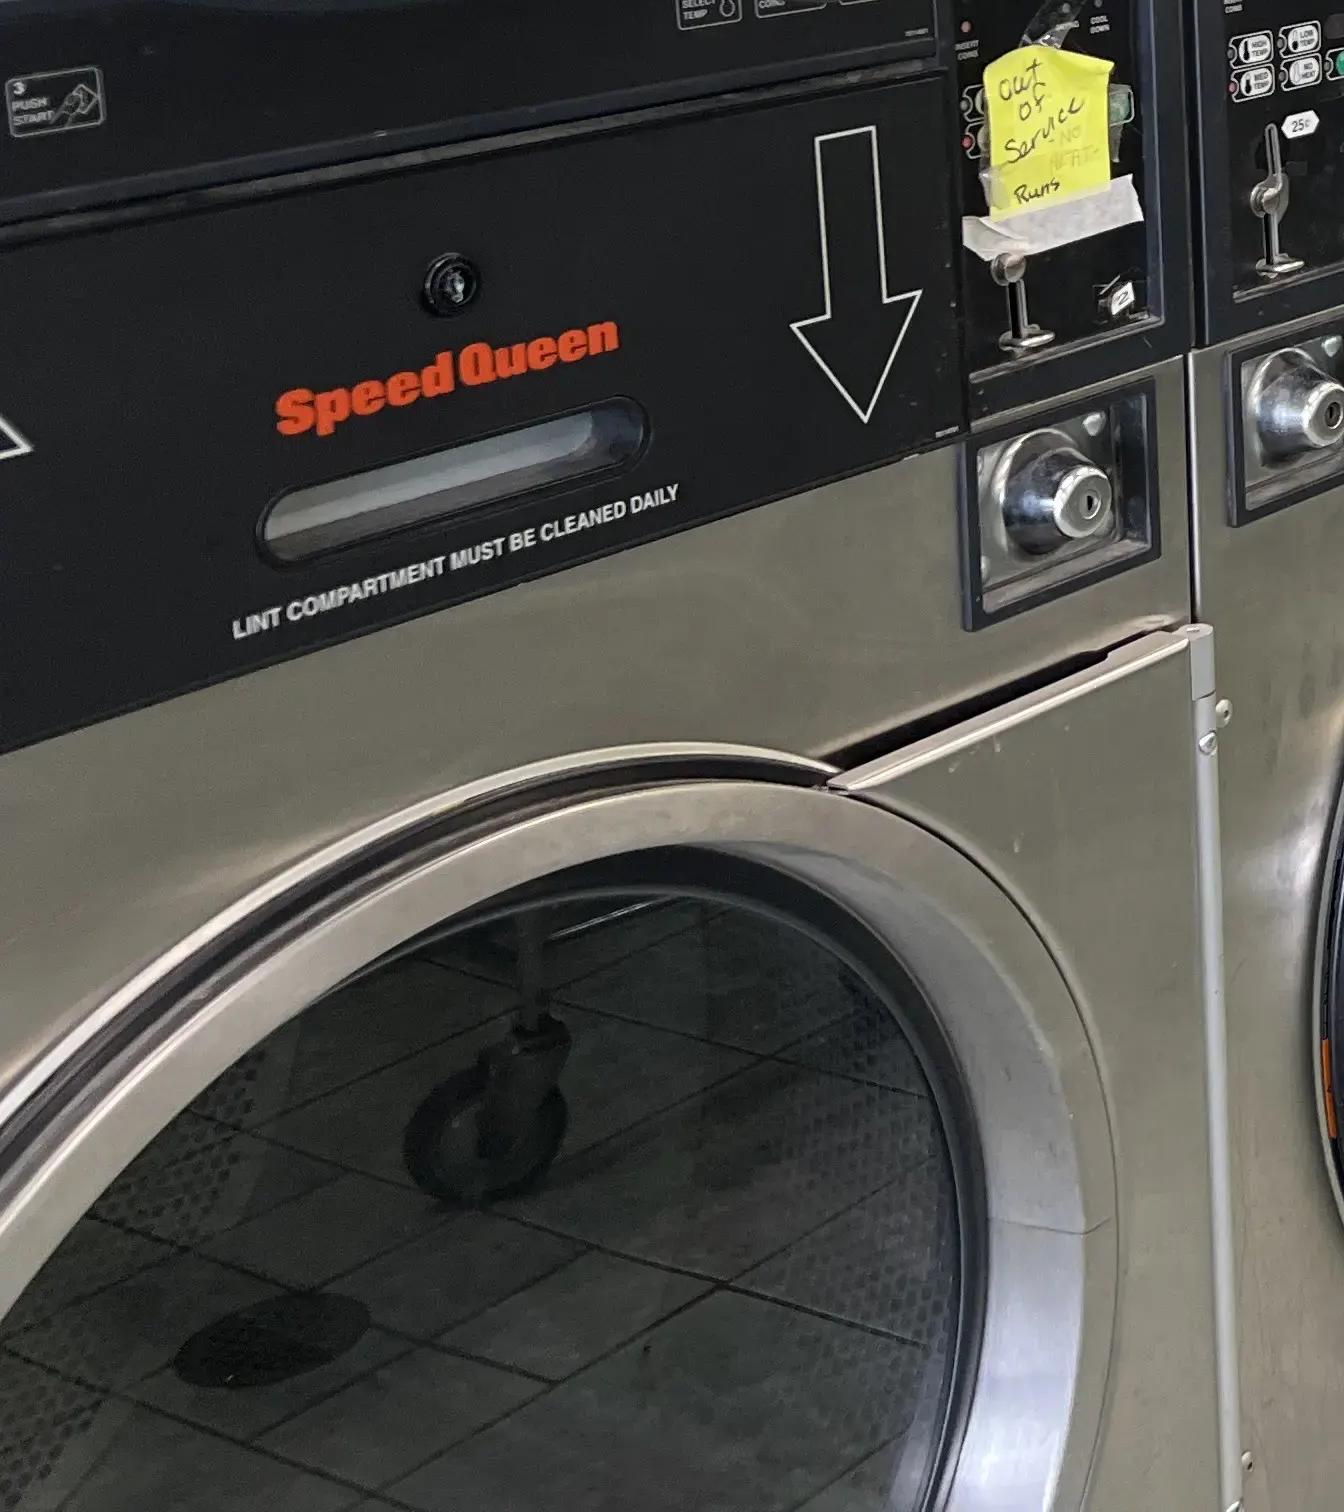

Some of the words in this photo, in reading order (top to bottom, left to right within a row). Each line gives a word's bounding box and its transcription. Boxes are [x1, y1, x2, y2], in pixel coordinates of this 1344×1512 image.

[683, 9, 708, 20] TEMP
[275, 351, 455, 437] Speed
[459, 320, 619, 386] Queen
[232, 607, 282, 641] LINT
[286, 555, 447, 622] COMPARTMENT
[449, 535, 505, 572] MUST
[508, 528, 537, 553] BE
[539, 500, 627, 543] CLEANED
[629, 483, 680, 515] DAILY
